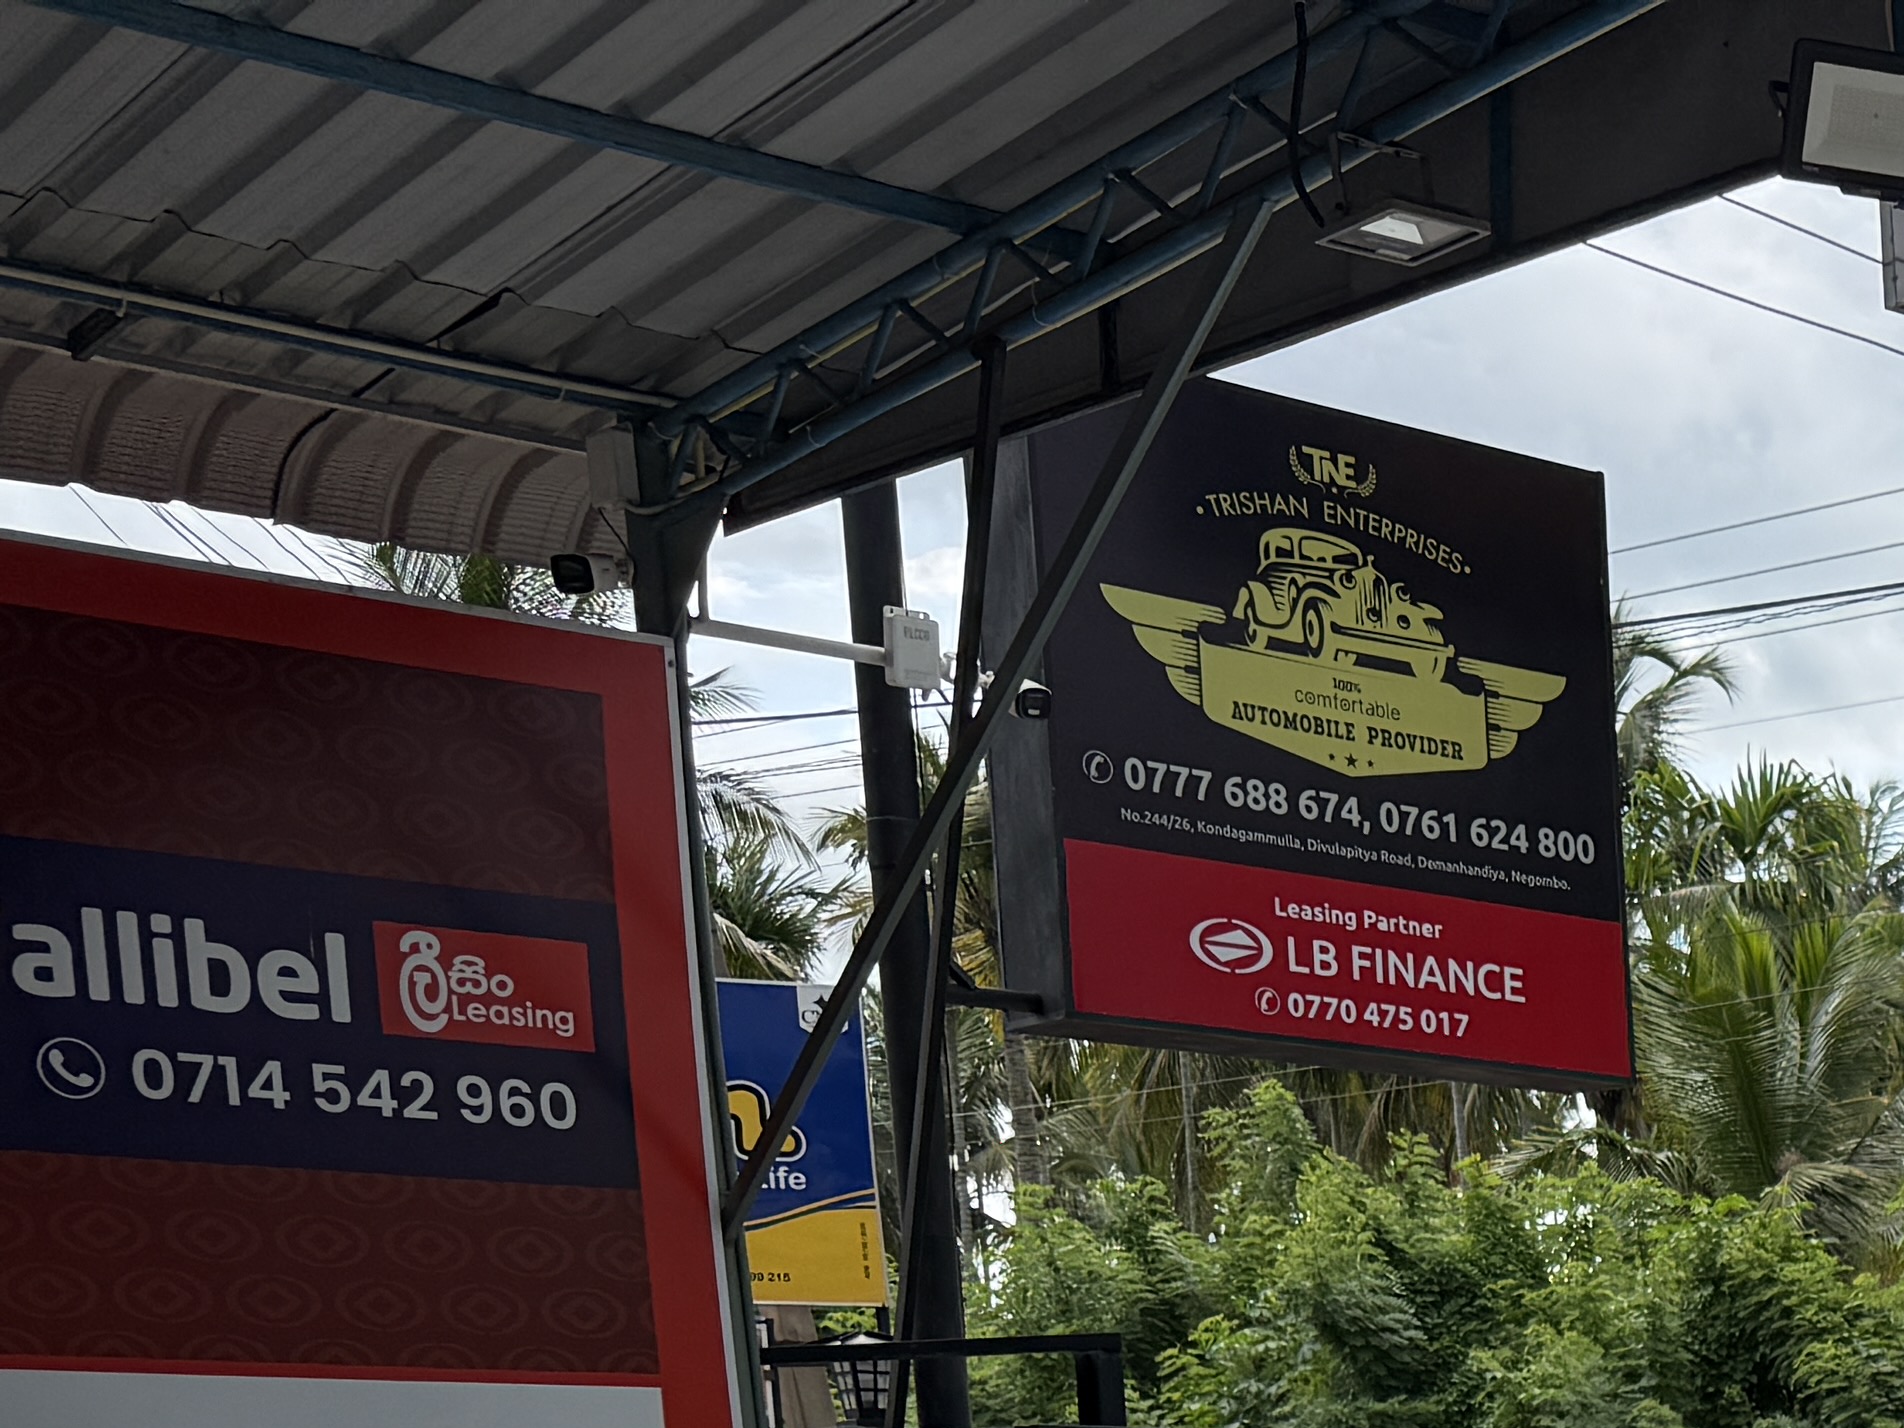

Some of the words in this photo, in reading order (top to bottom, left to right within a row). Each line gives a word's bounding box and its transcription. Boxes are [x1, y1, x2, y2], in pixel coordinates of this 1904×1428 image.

[1205, 491, 1309, 520] TRISHAN
[1323, 500, 1463, 576] ENTERPRISES
[1294, 689, 1401, 721] comfortable
[1332, 677, 1362, 694] 100%
[1231, 700, 1356, 742] AUTOMOBILE
[1366, 726, 1464, 761] PROVIDER
[1124, 757, 1213, 802] 0777
[1224, 776, 1289, 816] 688
[1298, 789, 1372, 836] 674,
[1379, 801, 1458, 843] 0761
[1470, 817, 1530, 855] 624
[1537, 826, 1597, 866] 800
[1120, 807, 1195, 835] No.244/26,
[1197, 819, 1306, 853] Kondagammulla,
[1306, 837, 1379, 864] Divulapitya
[1380, 850, 1417, 870] Road,
[1511, 869, 1572, 892] Negombo.
[1274, 896, 1357, 931] Leasing
[1363, 909, 1443, 939] Partner
[11, 907, 352, 1024] allibel
[1286, 935, 1339, 977] LB
[1351, 944, 1527, 1003] FINANCE
[451, 995, 576, 1038] Leasing
[1287, 992, 1357, 1024] 0770
[1363, 1002, 1414, 1031] 475
[1420, 1009, 1469, 1038] 017
[132, 1048, 291, 1111] 0714
[312, 1063, 440, 1121] 542
[457, 1074, 579, 1131] 960
